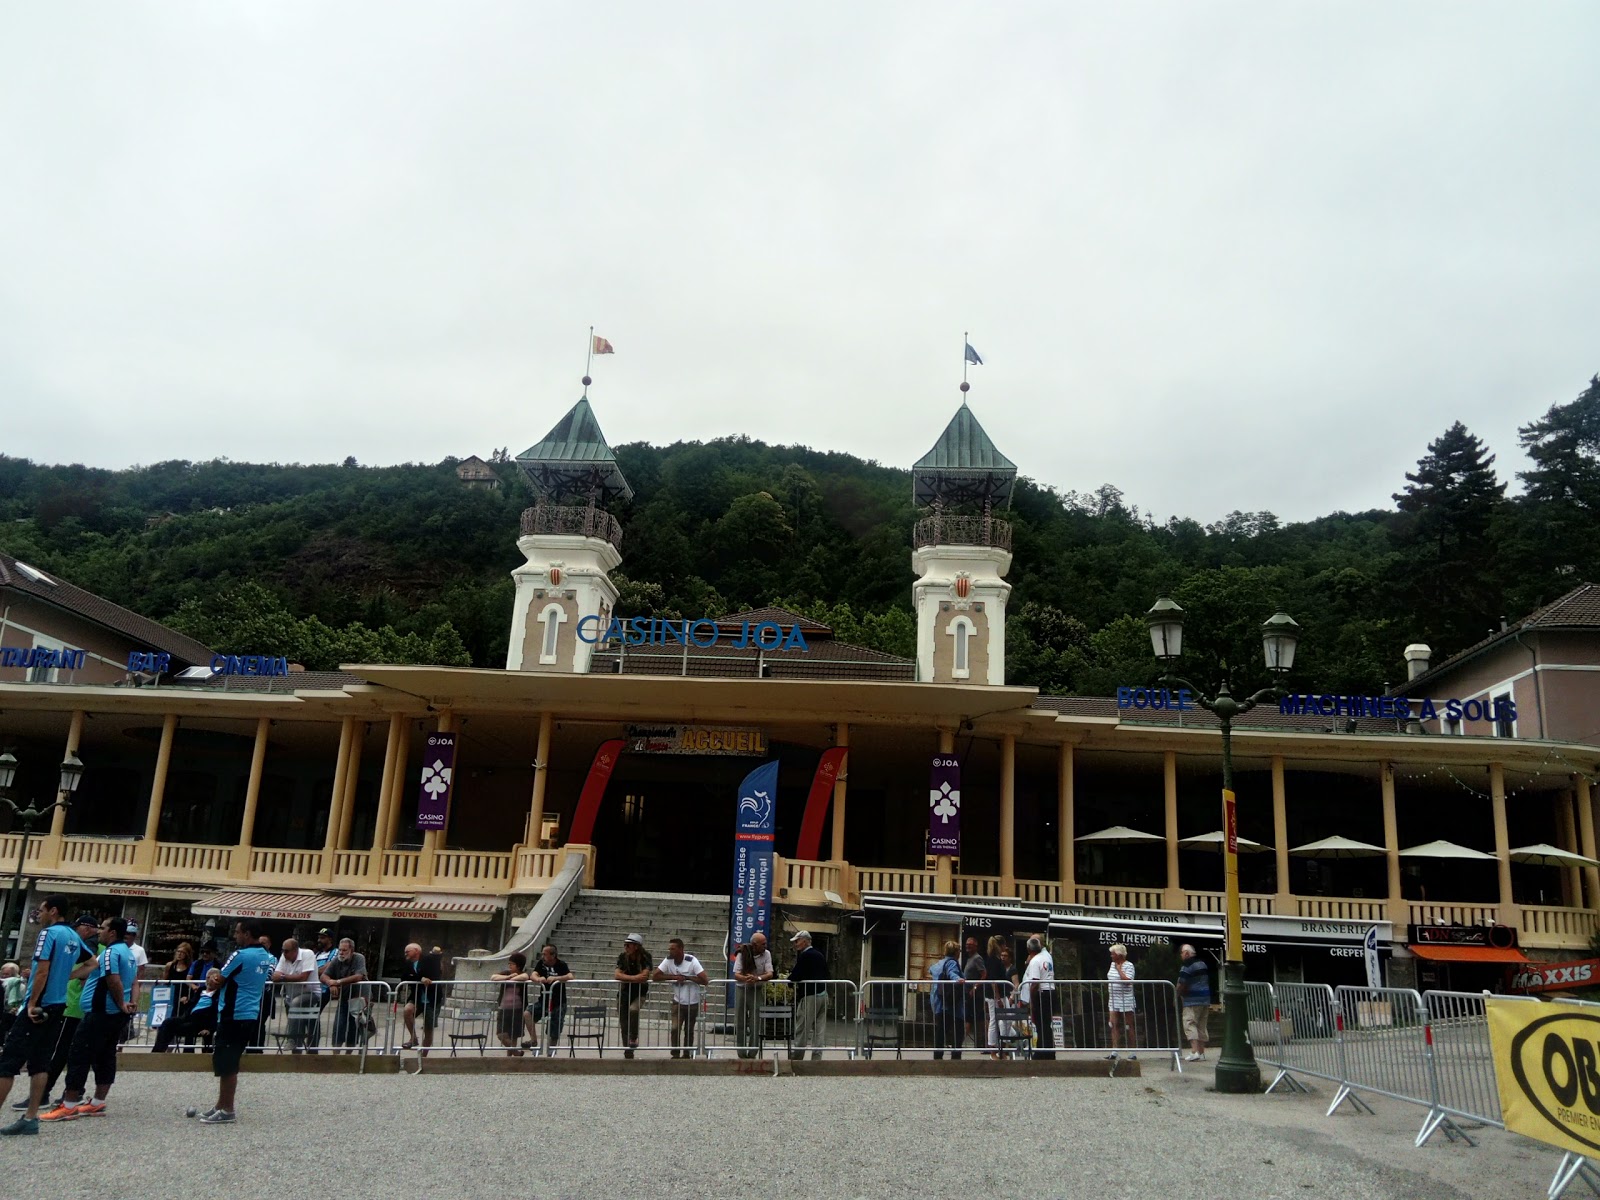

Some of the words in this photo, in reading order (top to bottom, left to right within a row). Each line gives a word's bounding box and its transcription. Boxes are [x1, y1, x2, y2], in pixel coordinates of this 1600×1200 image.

[577, 615, 719, 648] CASINO
[732, 620, 809, 652] JOA
[0, 647, 86, 670] TAURANT
[128, 651, 170, 673] BAR
[210, 654, 288, 677] CINEMA
[1117, 686, 1193, 711] BOULE
[1279, 693, 1411, 720] MACHINES
[1420, 696, 1438, 720] A
[1445, 698, 1518, 722] SOUS
[681, 729, 766, 752] ACCUEIL
[109, 888, 149, 896] SOUVENIRS
[277, 911, 311, 919] PARADIS
[391, 911, 438, 919] SOUVENIRS
[745, 916, 754, 929] de
[1098, 931, 1118, 941] LES
[1121, 933, 1170, 946] THERMES
[1301, 923, 1366, 935] BRASSERIE
[1510, 964, 1593, 989] MAXXIS
[1542, 1032, 1600, 1116] OB
[1557, 1107, 1588, 1128] PREMIER
